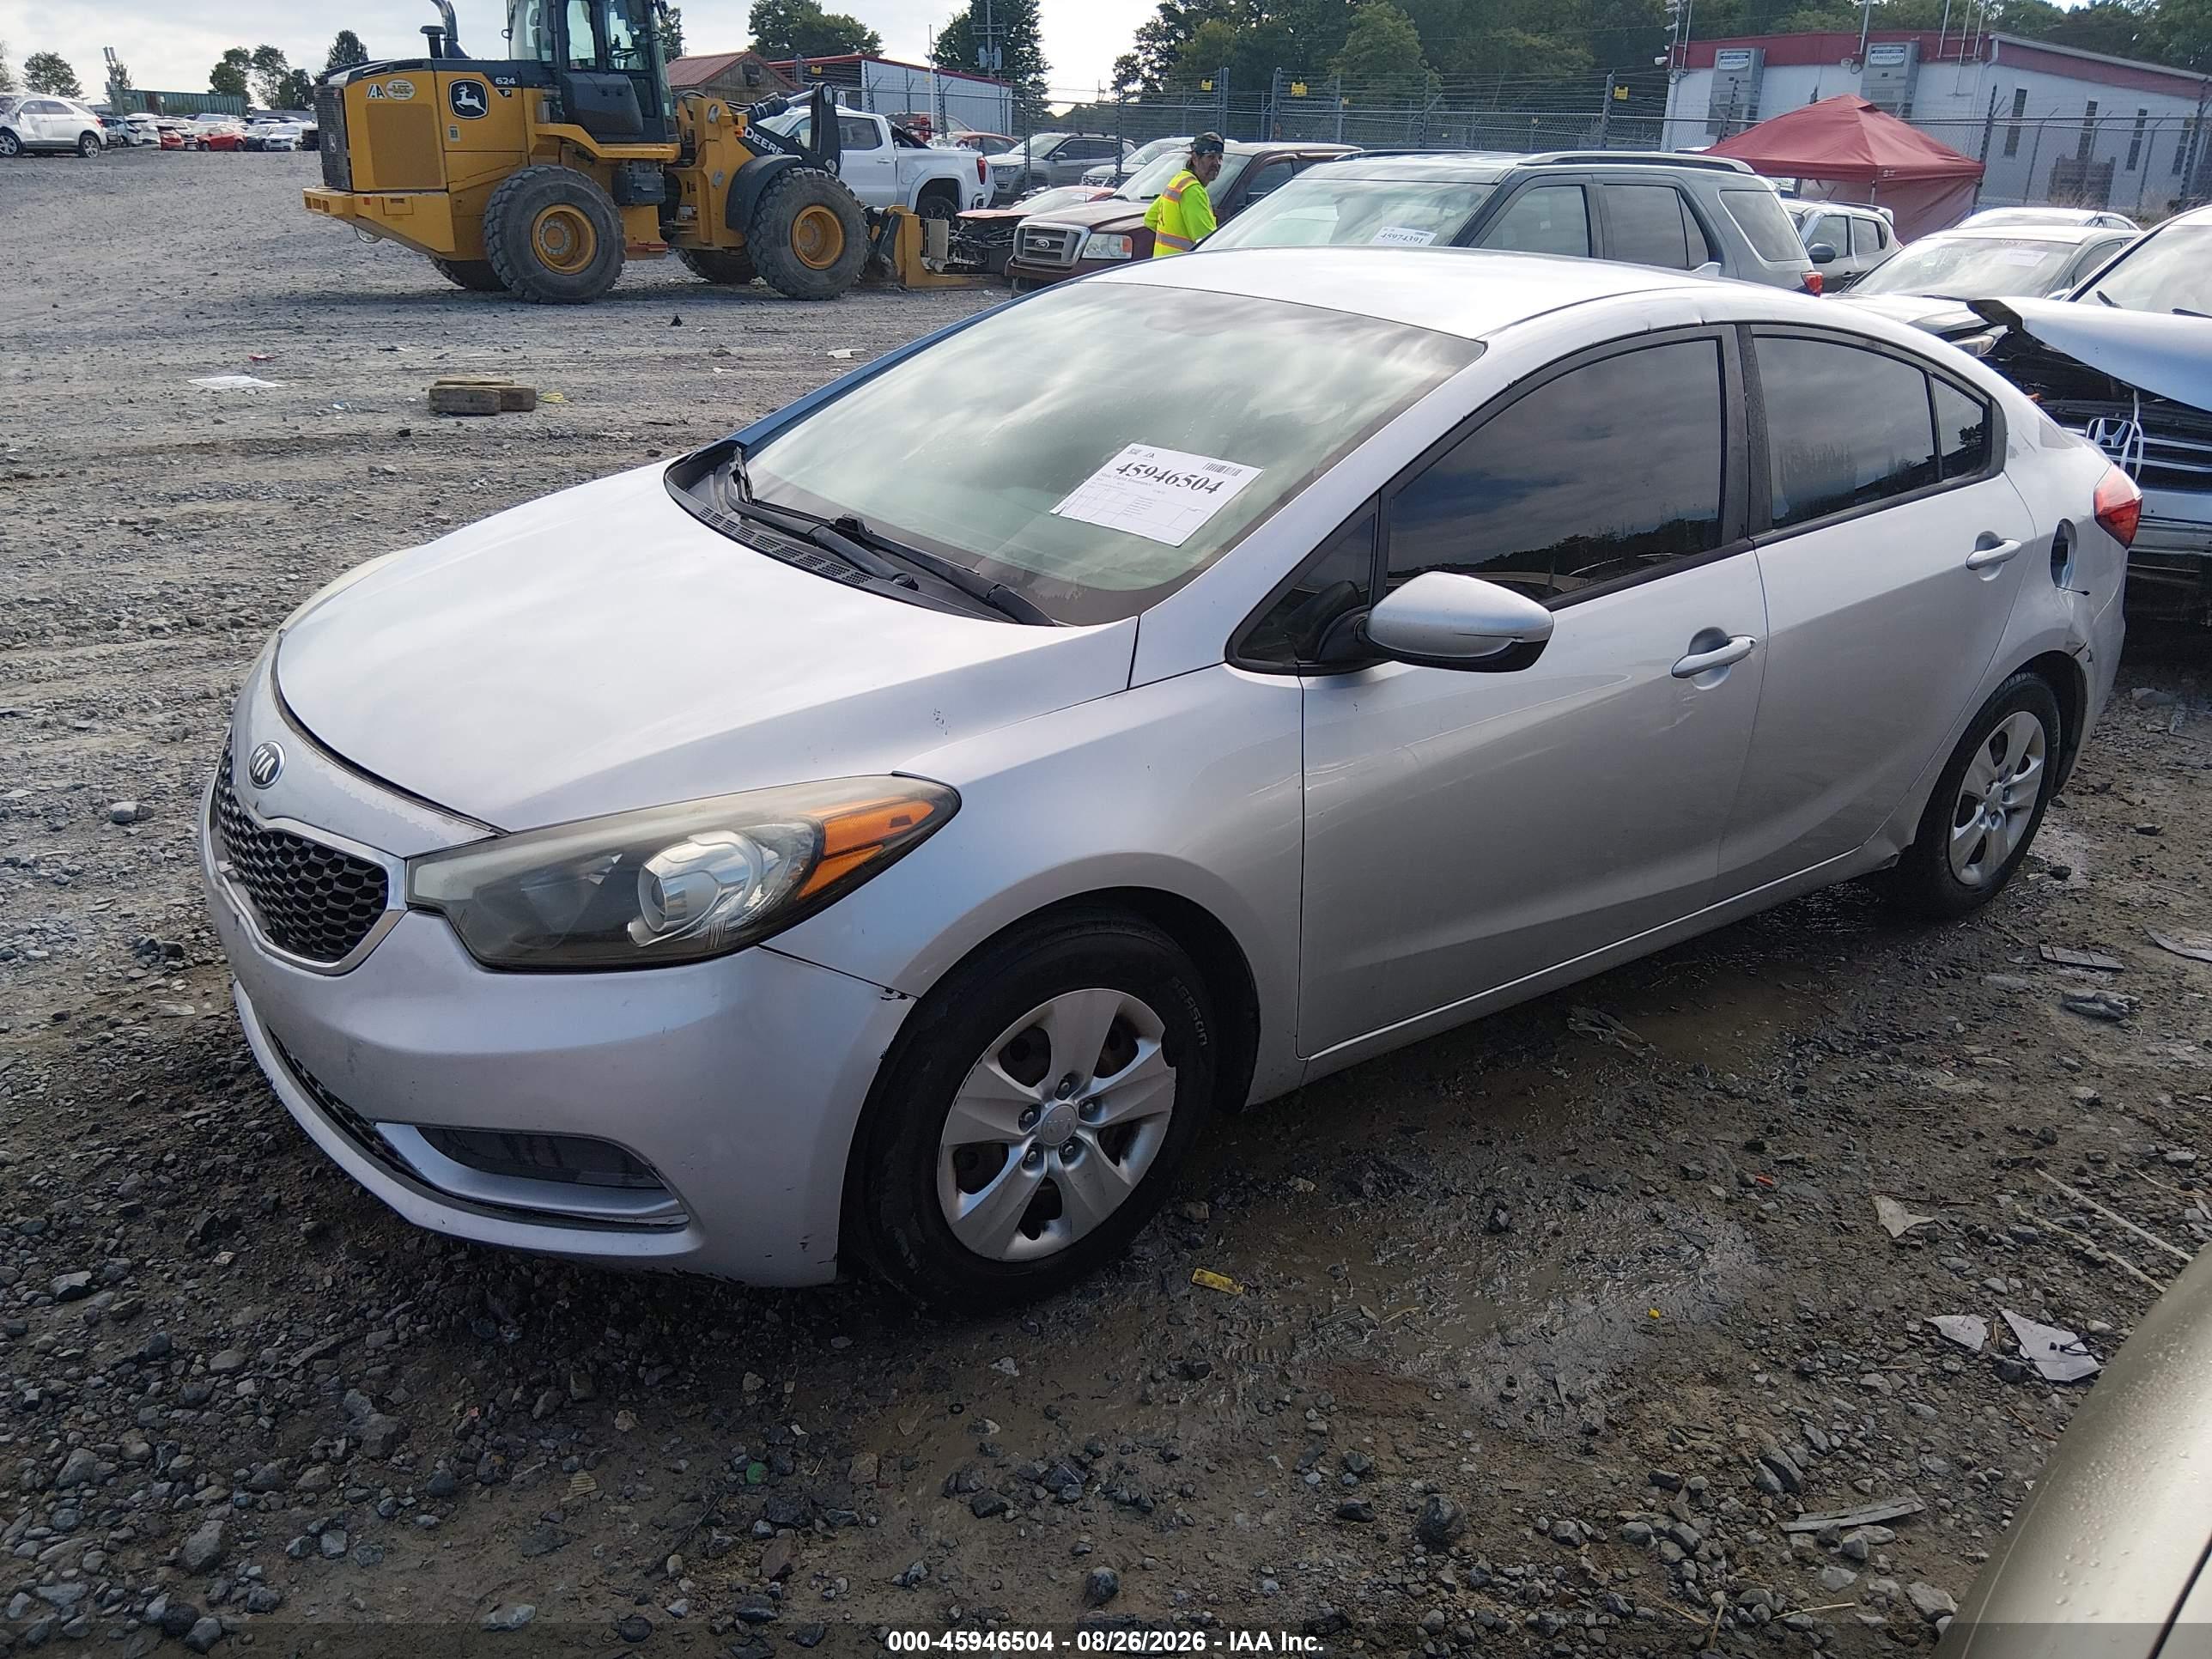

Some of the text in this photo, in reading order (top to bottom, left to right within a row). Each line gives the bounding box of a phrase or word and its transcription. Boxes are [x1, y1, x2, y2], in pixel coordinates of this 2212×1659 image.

[495, 76, 515, 85] 624
[744, 126, 785, 155] DEERE
[1115, 461, 1225, 495] 45946504
